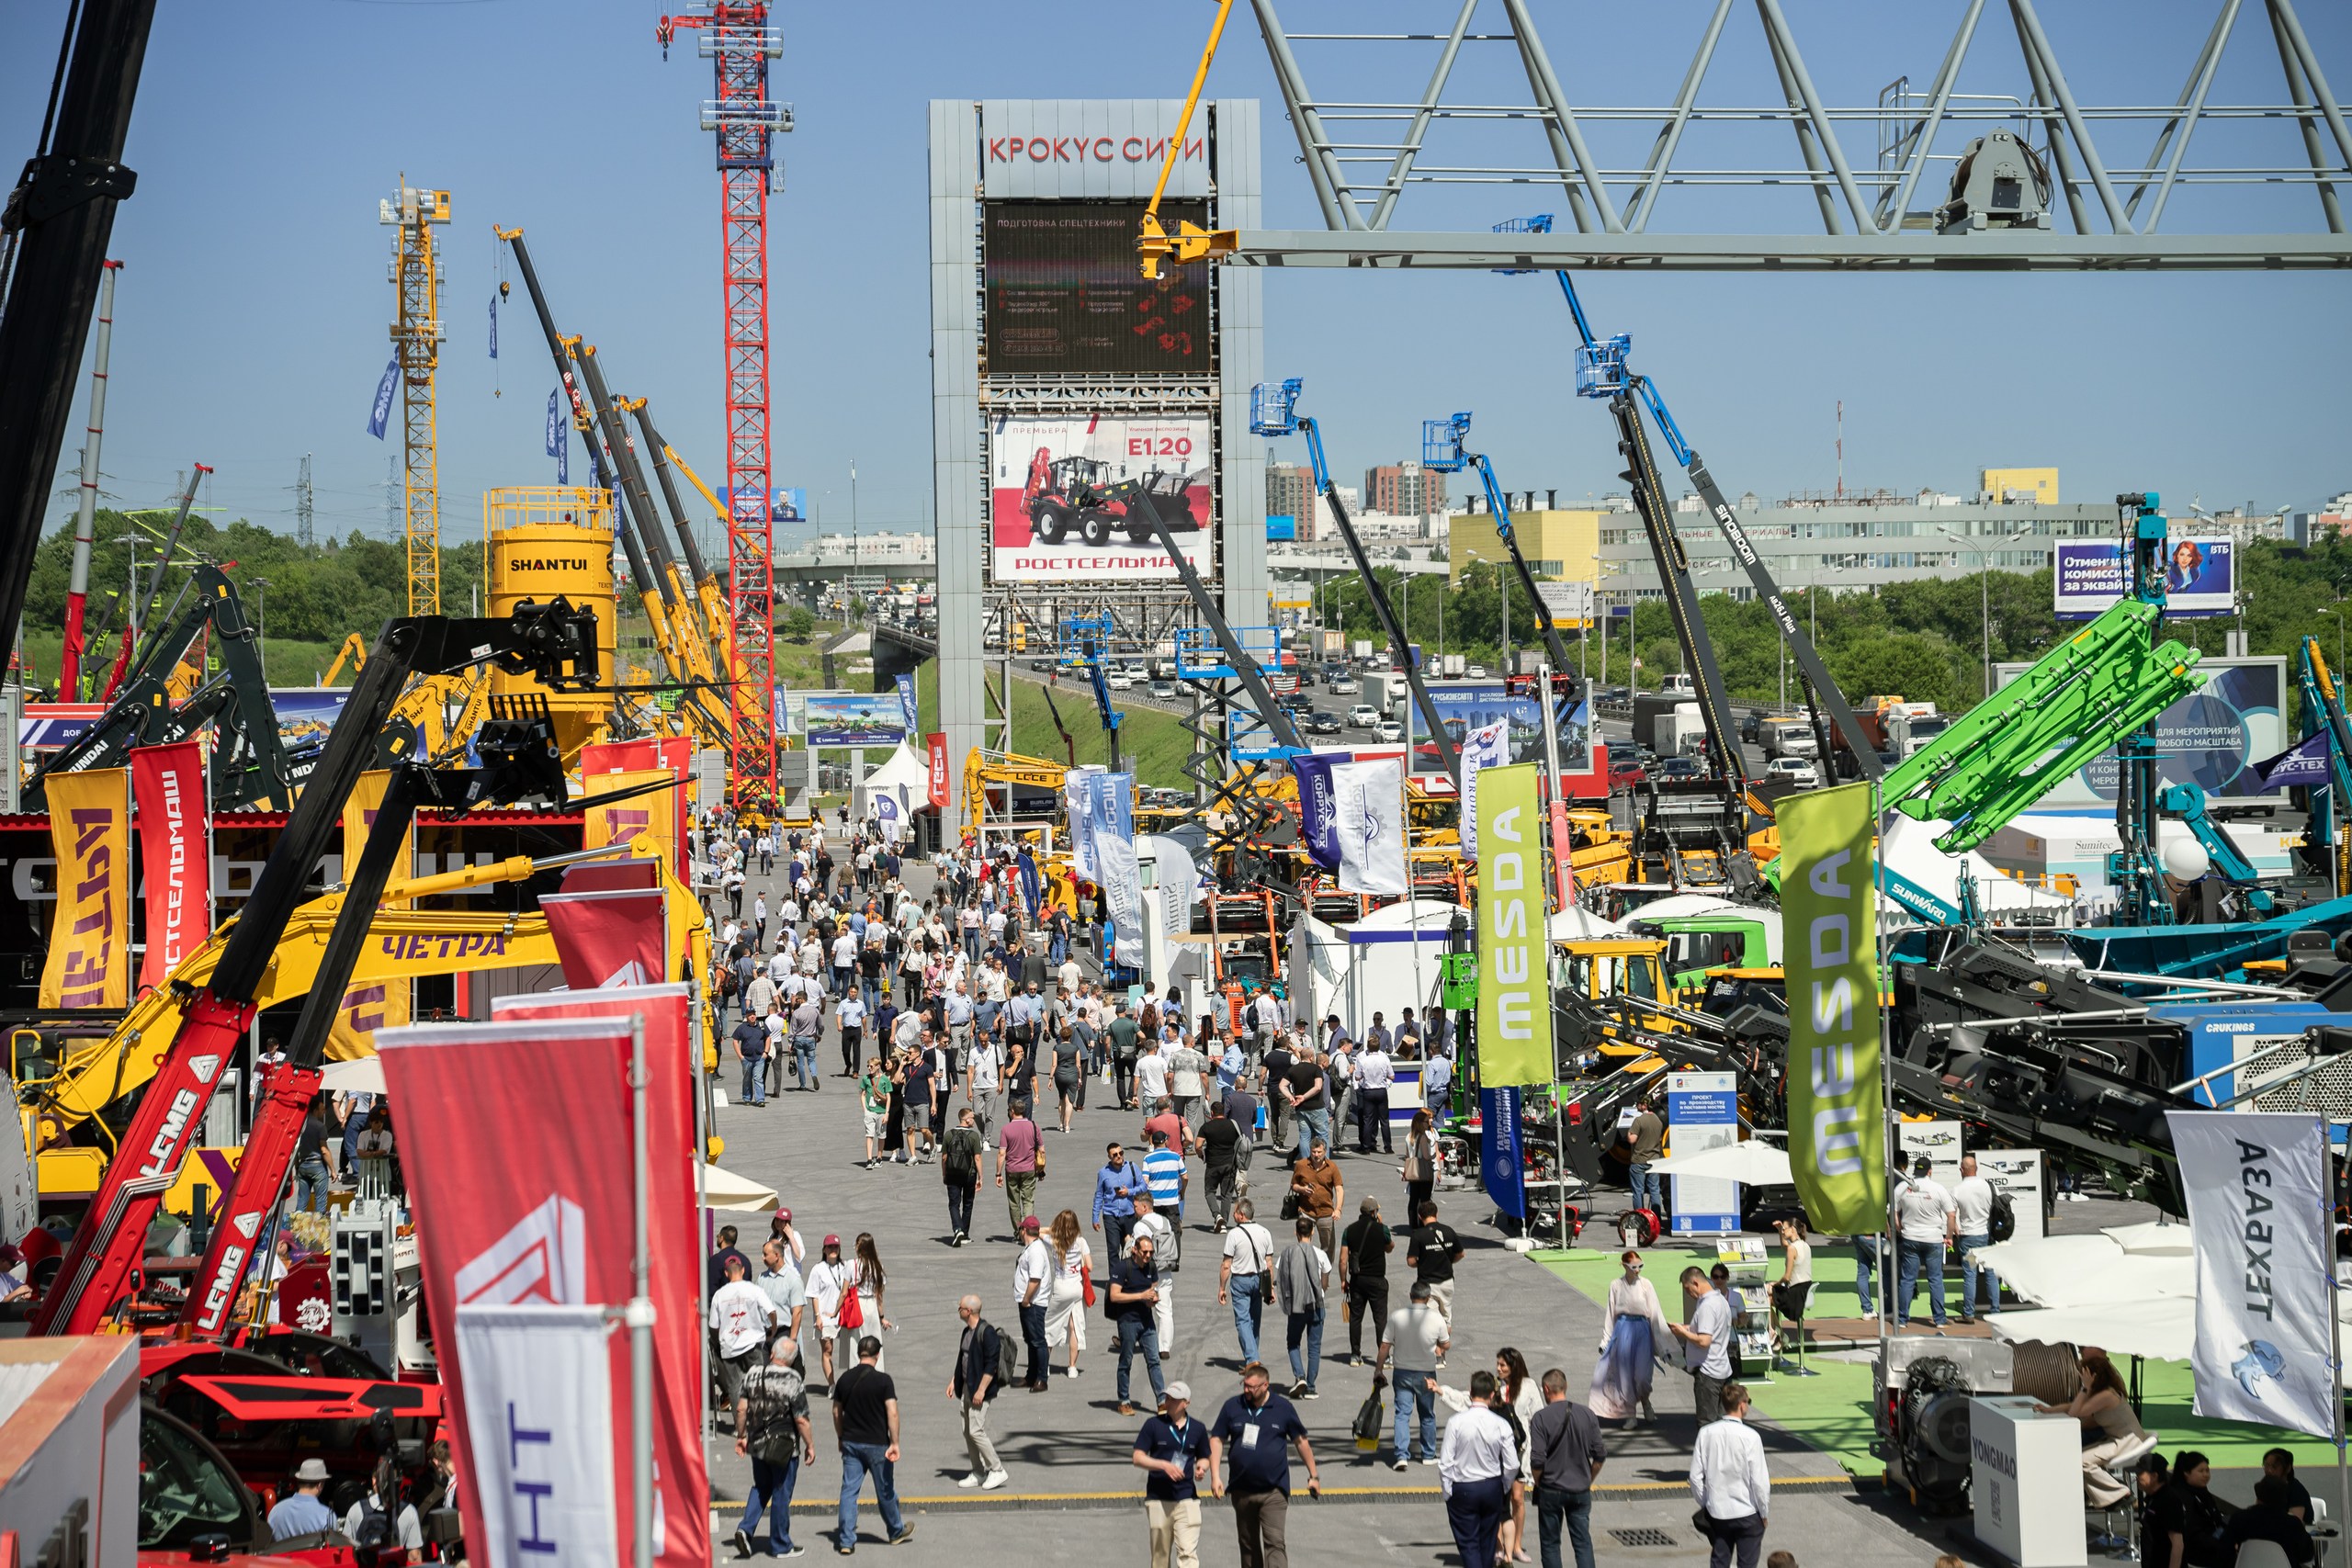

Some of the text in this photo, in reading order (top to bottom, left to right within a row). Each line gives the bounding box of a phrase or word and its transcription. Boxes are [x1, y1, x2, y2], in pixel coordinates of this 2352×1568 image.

[990, 138, 1114, 162] КРОКУС
[997, 219, 1125, 229] ПОДГОТОВКА СПЕЦТЕХНИКИ
[1629, 528, 1791, 540] СТРЛЬНЫЕ ЕРИАЛЫ
[1715, 504, 1757, 566] SINOBOOM
[2211, 545, 2229, 554] ВТБ
[511, 559, 587, 571] SHANTUI
[2064, 580, 2133, 592] за эквайр
[1781, 615, 1796, 634] Plus
[2155, 737, 2242, 747] ЛЮБОГО МАСШТАБА
[2177, 725, 2241, 736] МЕРОПРИЯТИЙ
[69, 739, 109, 773] UNDAI
[2271, 759, 2325, 774] РУС-ТЕХ
[1314, 774, 1327, 848] КОРРУС-ТЕХ
[1352, 784, 1367, 871] КОРРУС-ТЕХ
[2075, 840, 2113, 850] Sumitec
[162, 770, 186, 979] ОСТСЕЛЬМАШ
[1892, 882, 1947, 920] SUNWARD
[1493, 807, 1532, 1040] MESDA
[382, 932, 505, 960] ЧЕТРА
[1808, 850, 1862, 1177] MESDA
[2206, 1022, 2256, 1033] CRUKINGS
[1635, 1038, 1658, 1048] ELAZ
[1495, 1088, 1504, 1151] ГАЗПРОМБАН
[140, 1088, 199, 1179] LGMG
[197, 1245, 245, 1330] LGMG
[1972, 1436, 2017, 1481] YONGMAO
